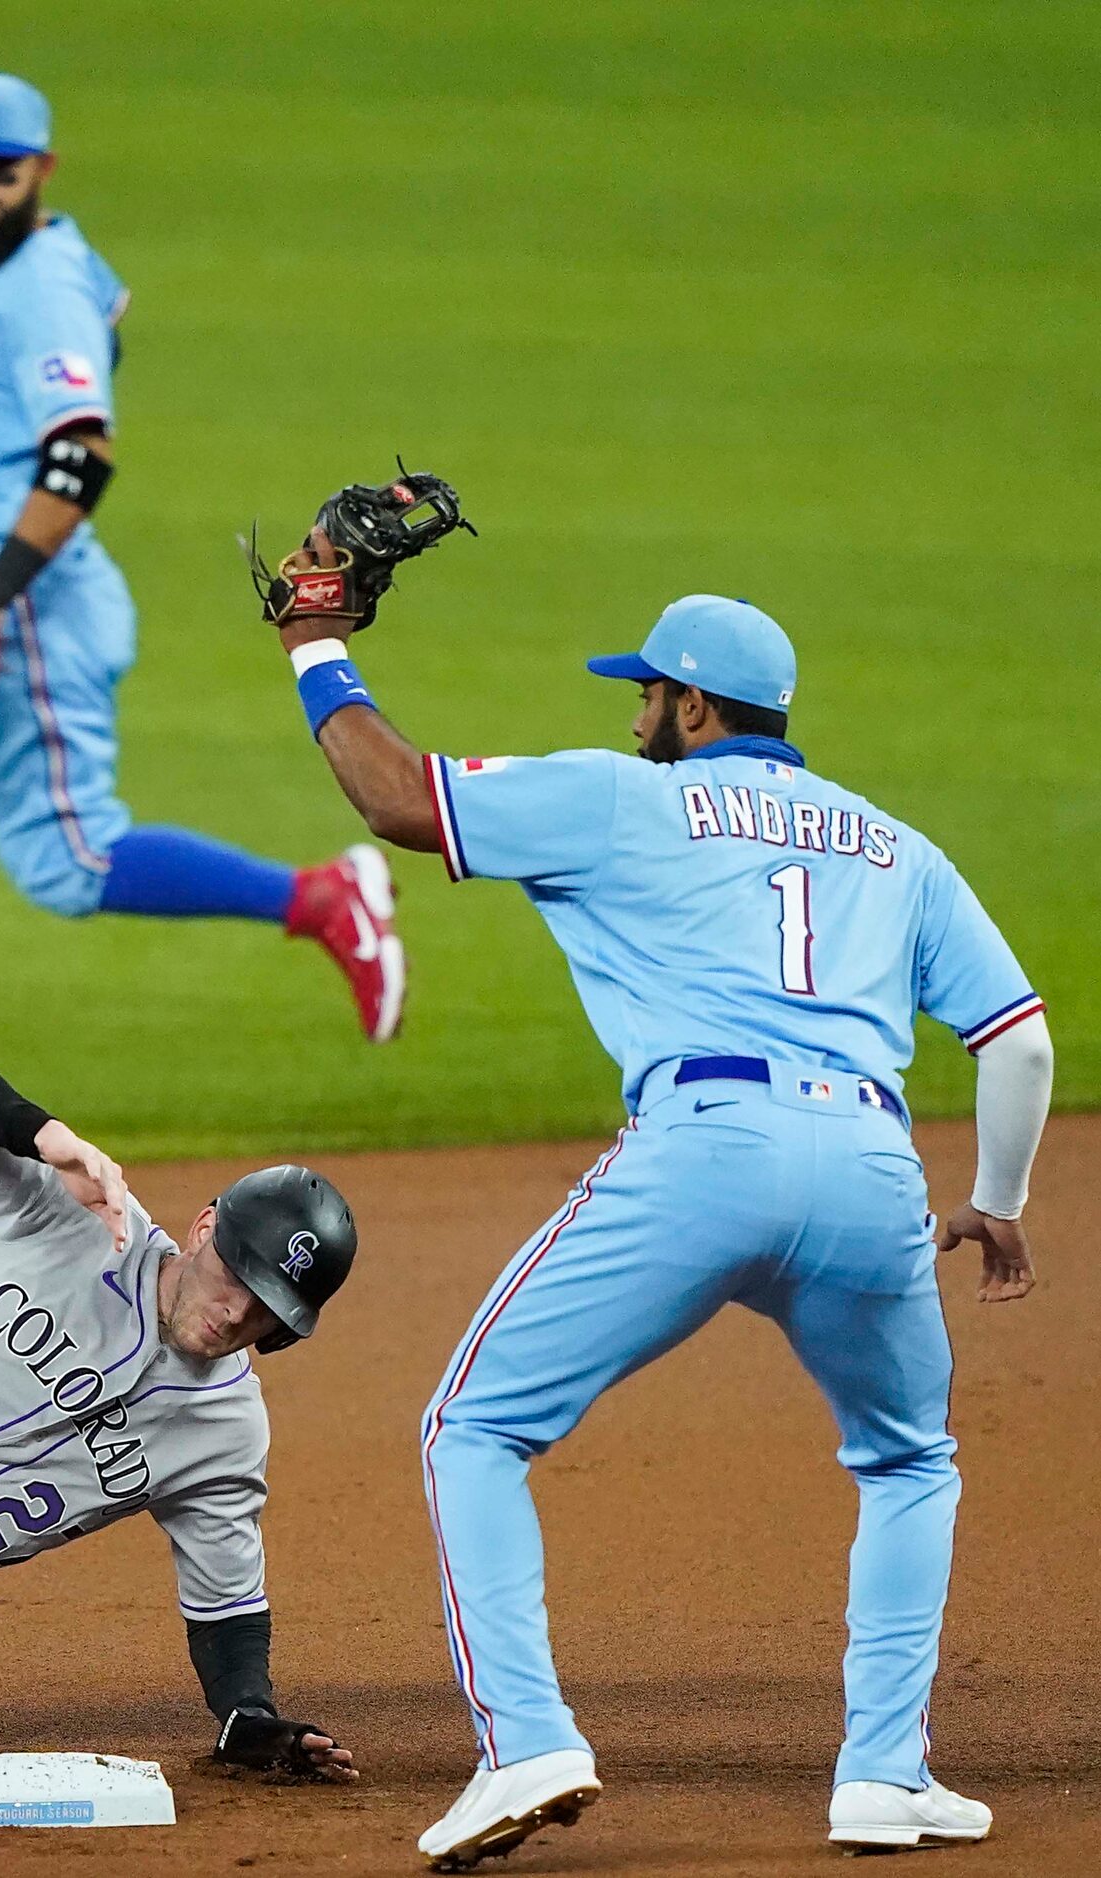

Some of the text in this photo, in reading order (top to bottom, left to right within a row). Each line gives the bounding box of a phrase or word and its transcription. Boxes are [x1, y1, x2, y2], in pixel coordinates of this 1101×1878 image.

[681, 783, 897, 868] ANDRUS
[768, 863, 816, 996] 1
[47, 1806, 90, 1819] SEASON
